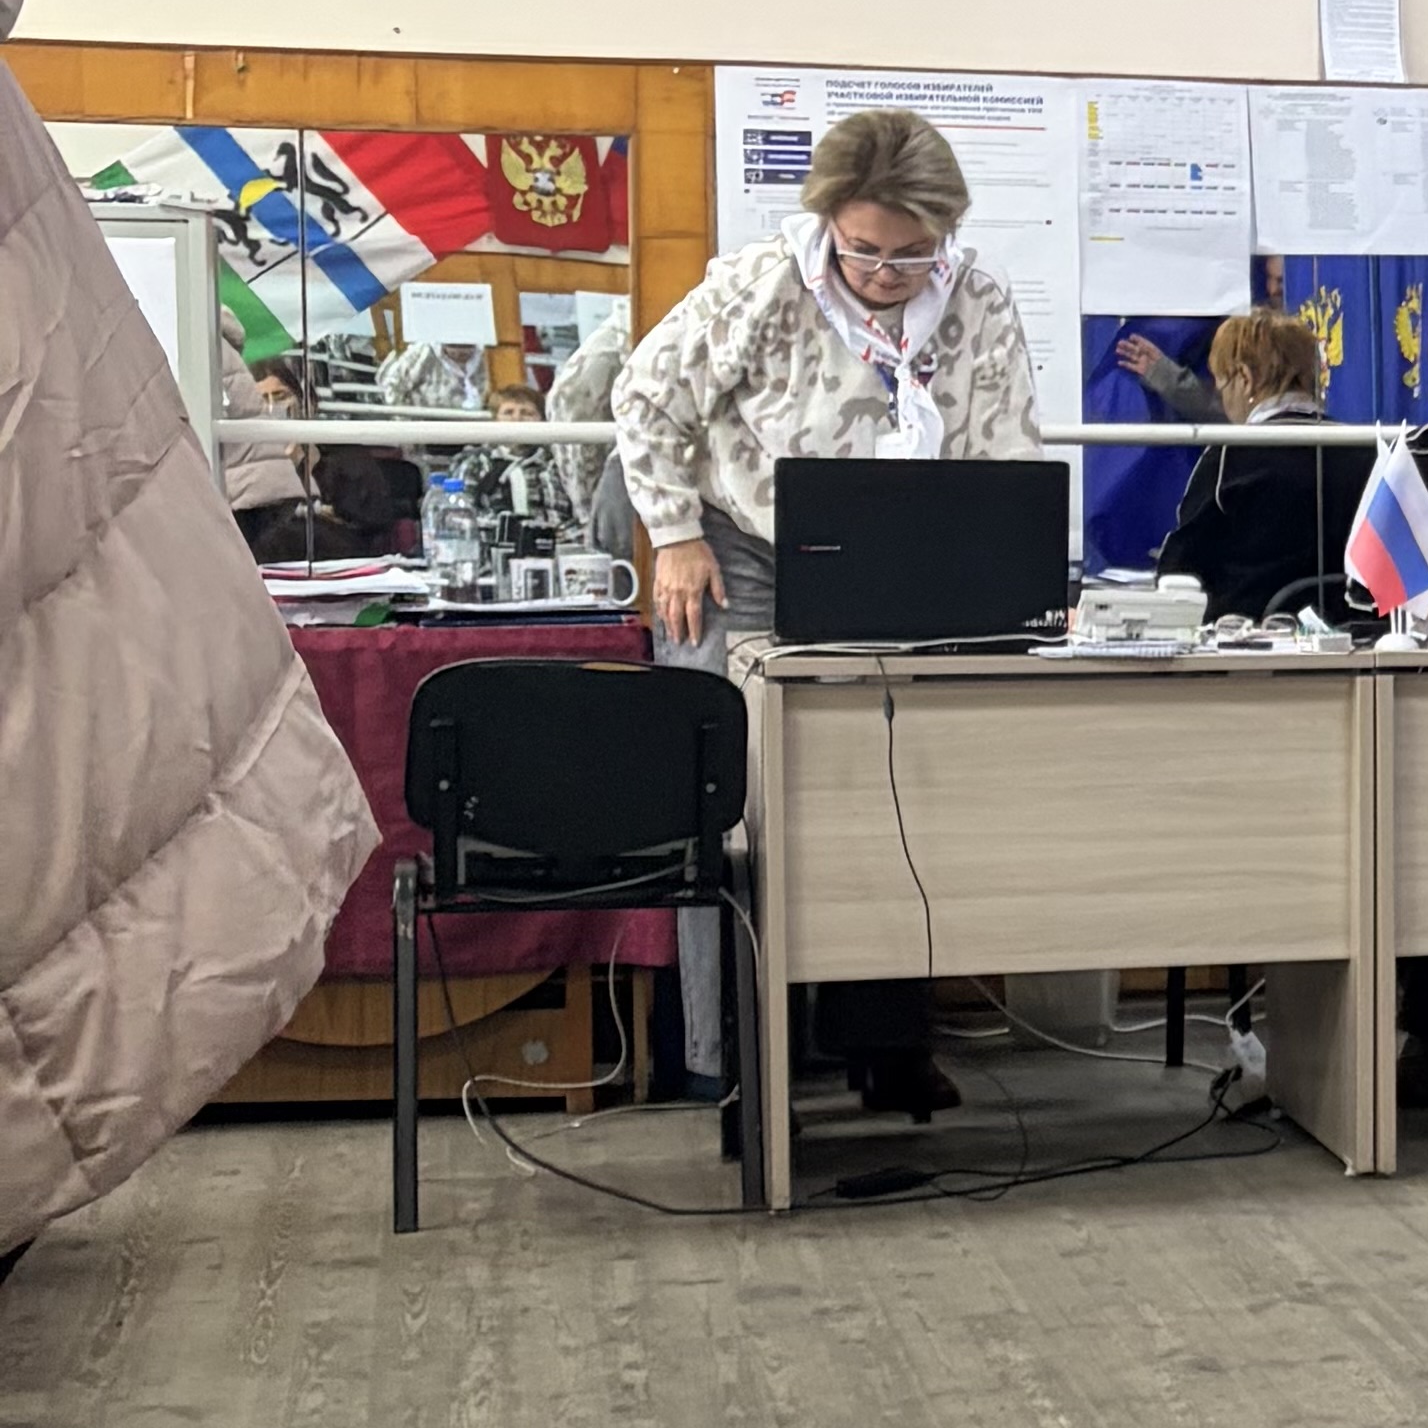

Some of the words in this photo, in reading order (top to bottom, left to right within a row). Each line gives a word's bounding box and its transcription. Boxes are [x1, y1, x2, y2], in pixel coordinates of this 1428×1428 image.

[874, 80, 921, 91] ГОЛОСОВ
[923, 82, 993, 93] ИЗБИРАТЕЛЕЙ
[827, 91, 893, 101] УЧАСТКОВОЙ
[896, 93, 980, 103] ИЗБИРАТЕЛЬНОЙ
[983, 95, 1044, 105] КОМИССИЕЙ
